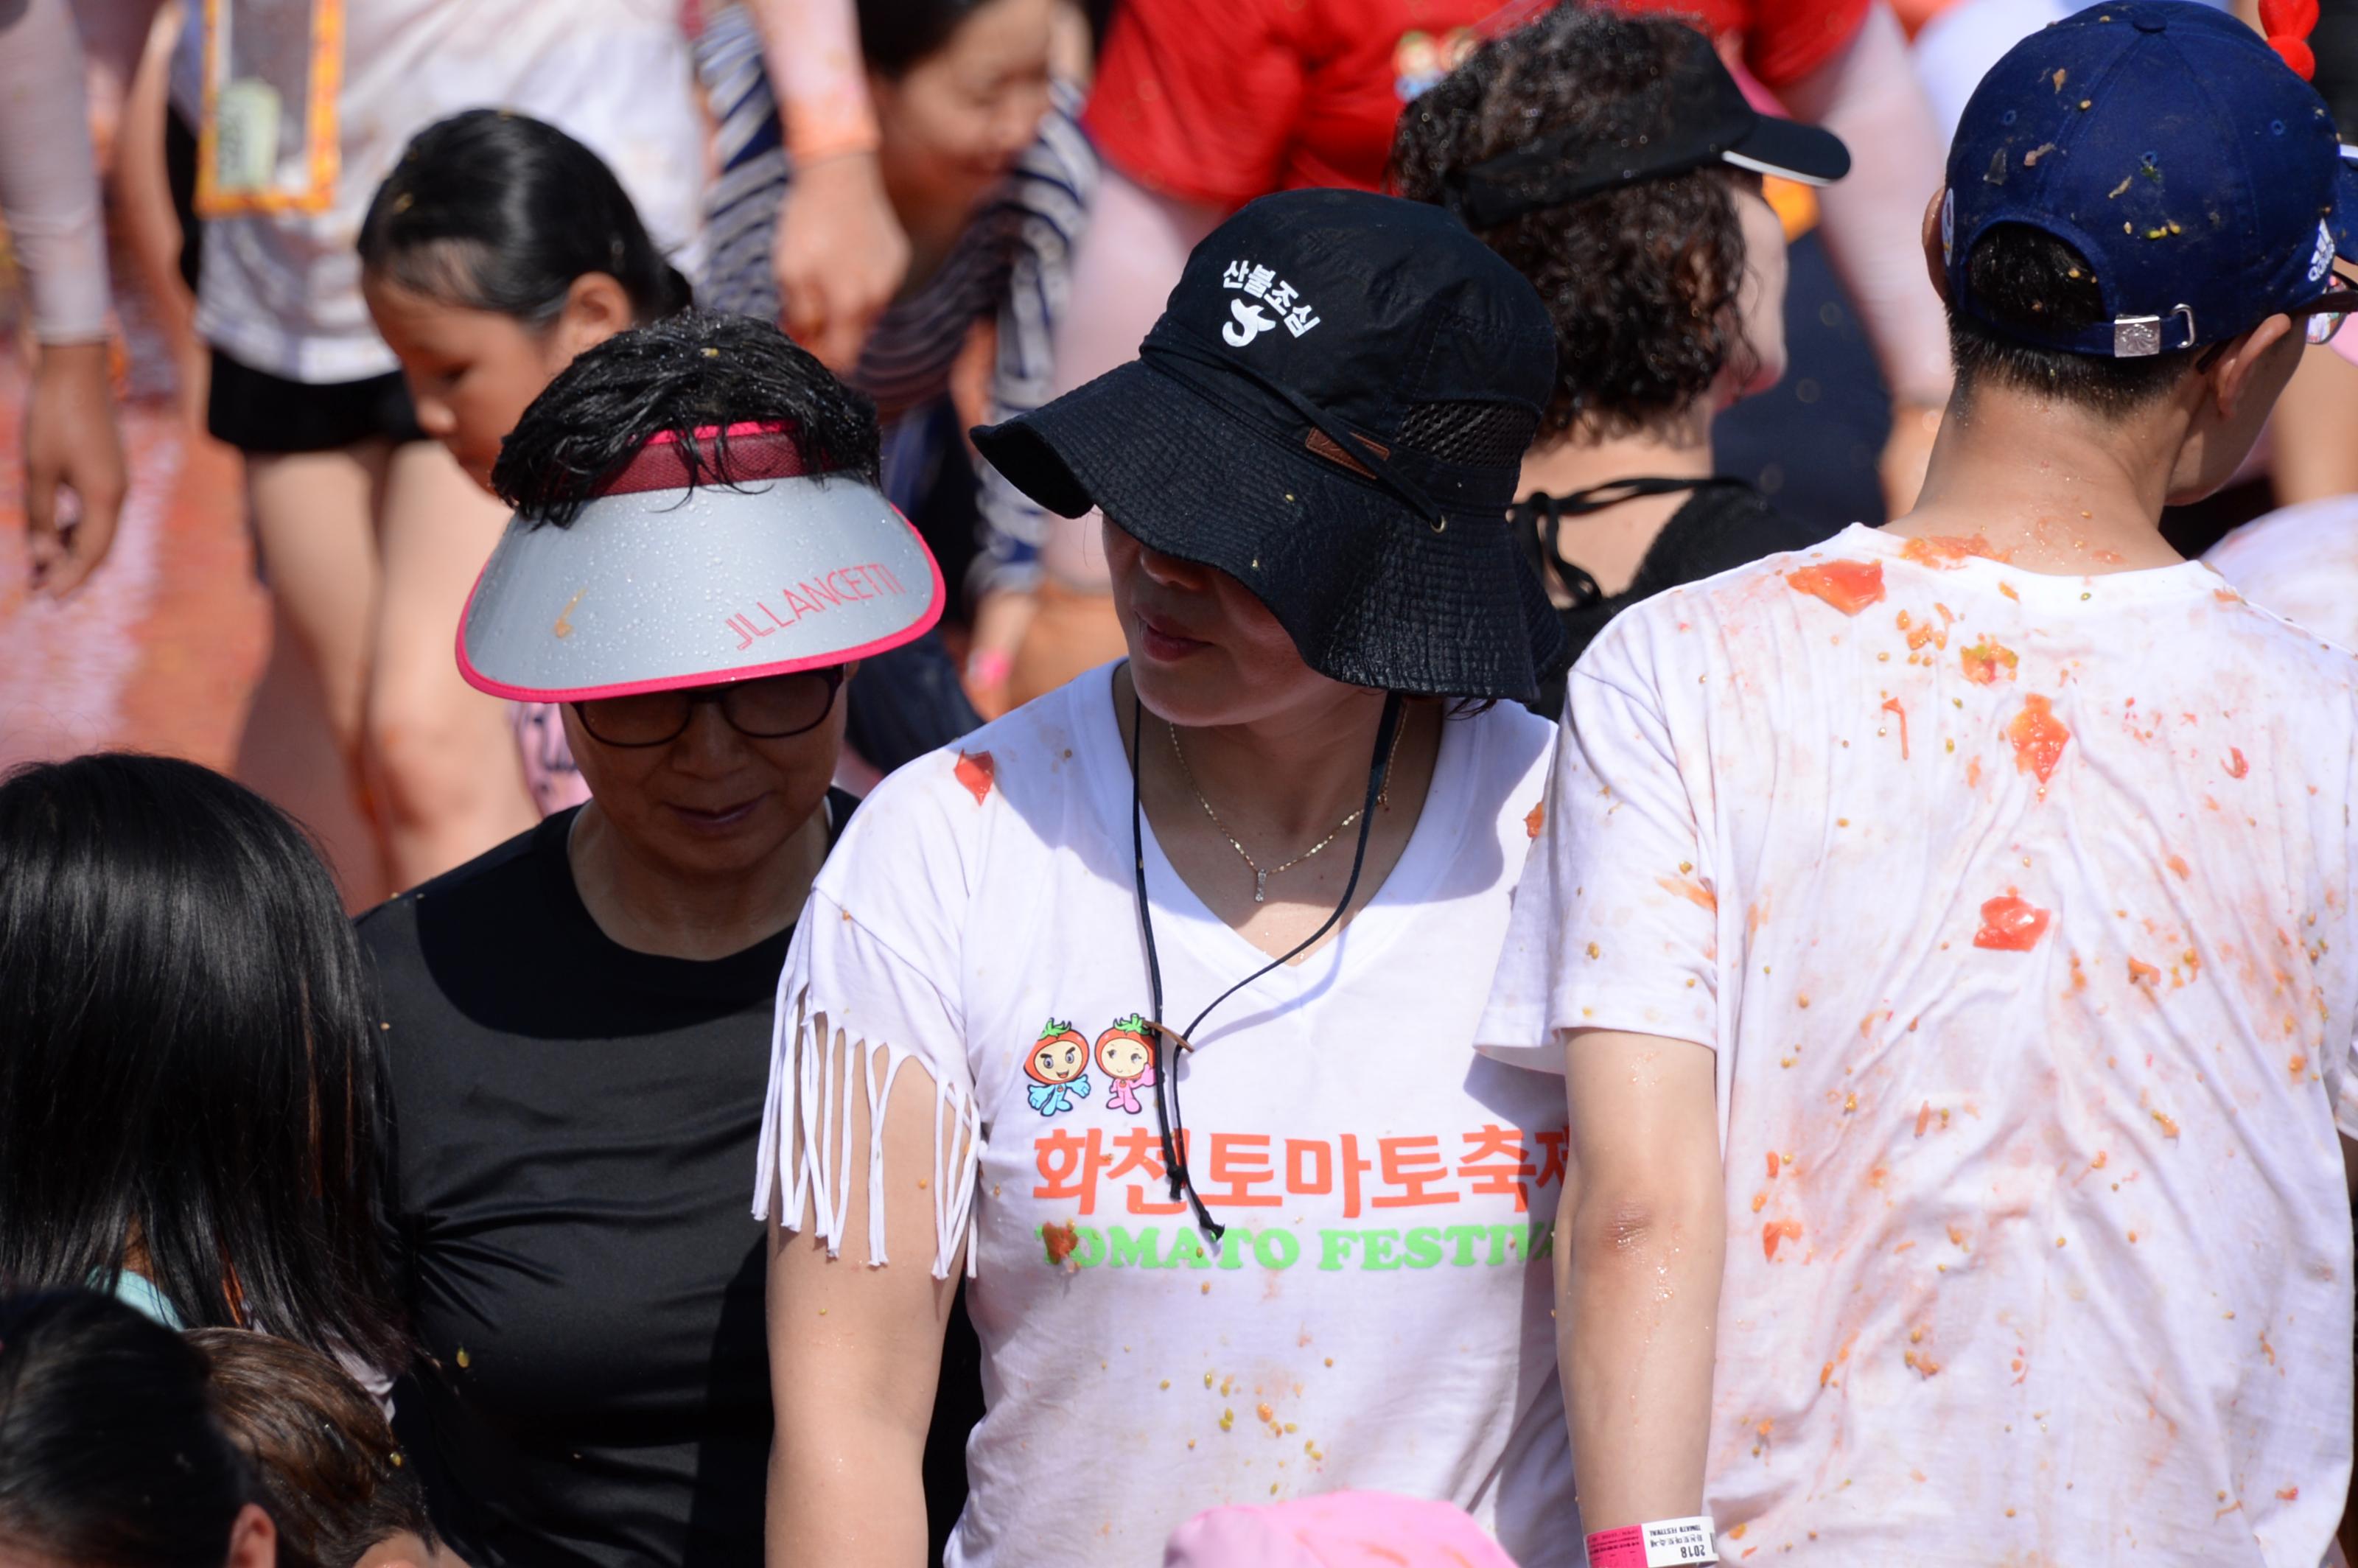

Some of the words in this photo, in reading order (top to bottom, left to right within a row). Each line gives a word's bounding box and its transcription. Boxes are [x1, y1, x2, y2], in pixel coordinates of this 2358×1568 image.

[1223, 260, 1320, 338] 산불조심
[1035, 1224, 1300, 1270] OMATO
[1681, 1544, 1705, 1558] 2018
